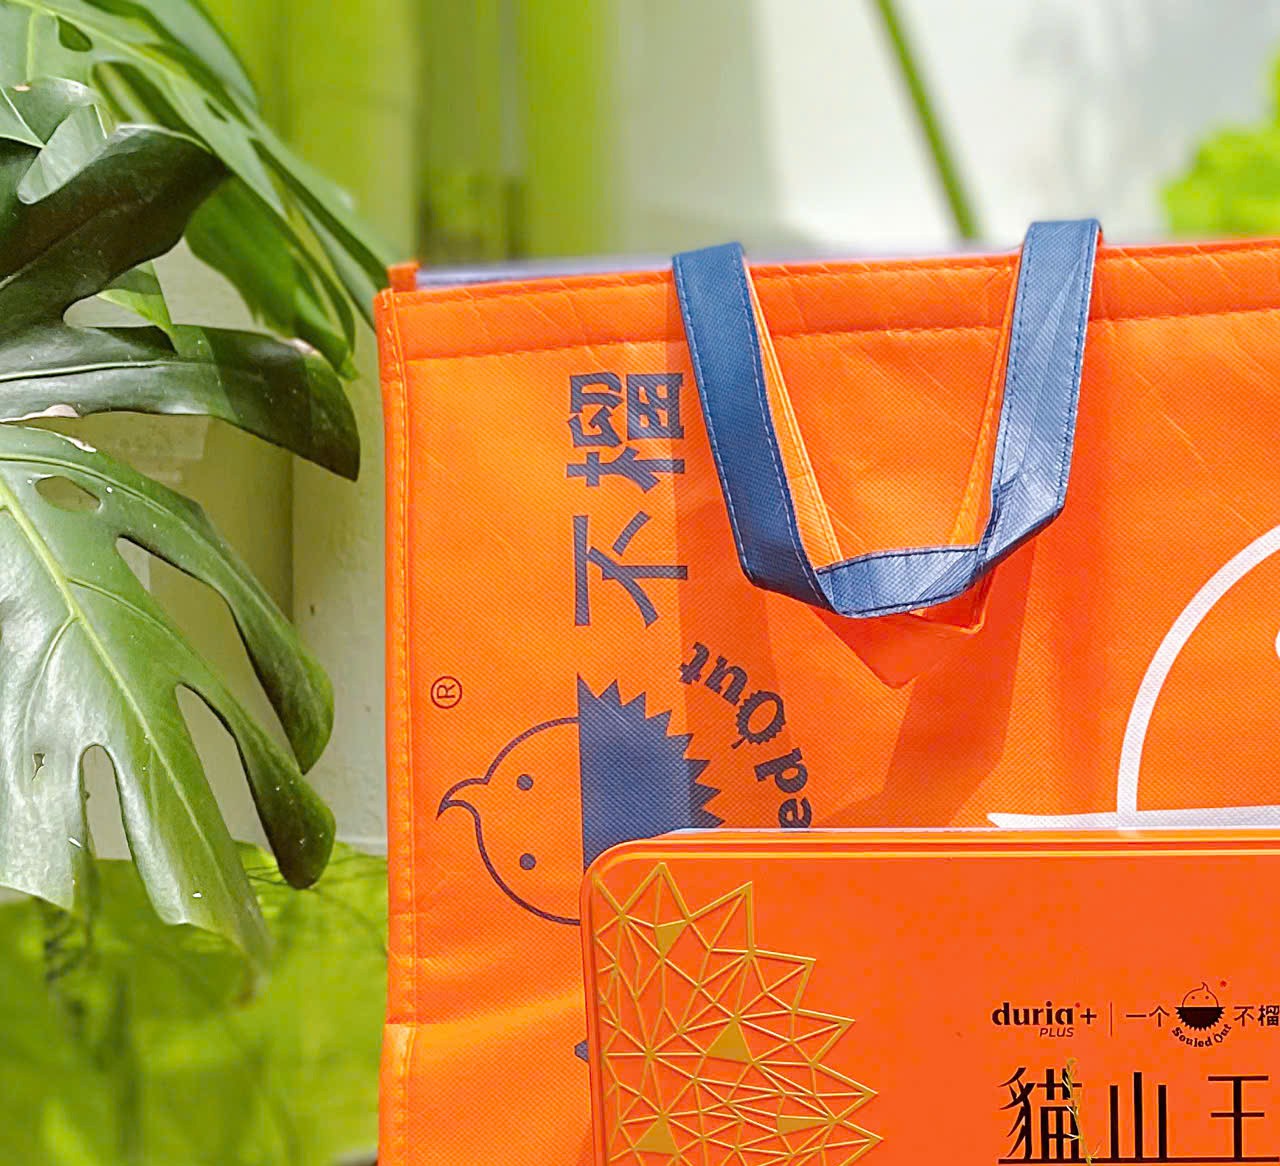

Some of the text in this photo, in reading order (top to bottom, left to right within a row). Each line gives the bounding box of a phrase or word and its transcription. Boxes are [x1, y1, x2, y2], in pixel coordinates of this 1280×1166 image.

[679, 641, 786, 750] Out
[1039, 1027, 1074, 1038] PLUS
[1171, 1023, 1232, 1048] Souled Out
[998, 1066, 1280, 1165] 貓山王
